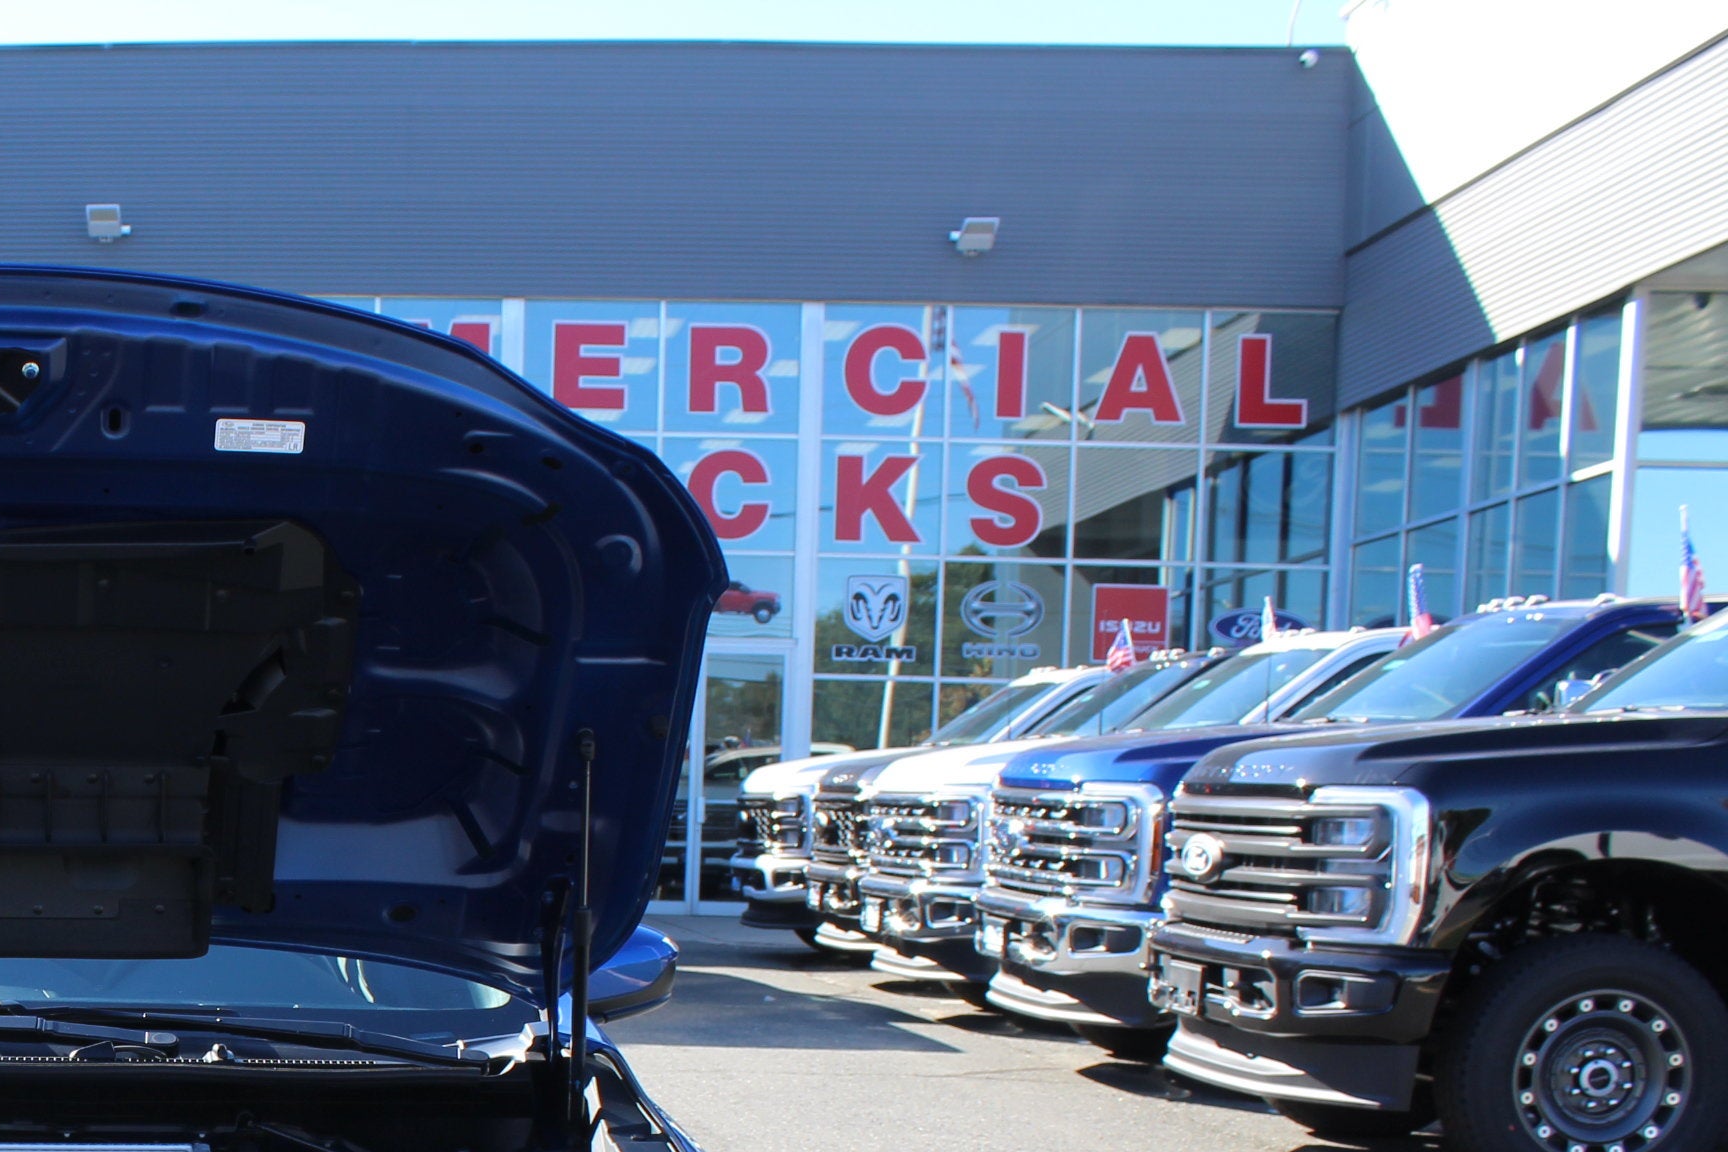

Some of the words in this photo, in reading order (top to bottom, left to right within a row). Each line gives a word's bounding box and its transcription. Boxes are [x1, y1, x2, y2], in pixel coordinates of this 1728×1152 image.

[410, 318, 1308, 430] ERCIAL
[688, 451, 1046, 548] CKS
[832, 644, 916, 661] RAM
[962, 642, 1040, 658] HINO
